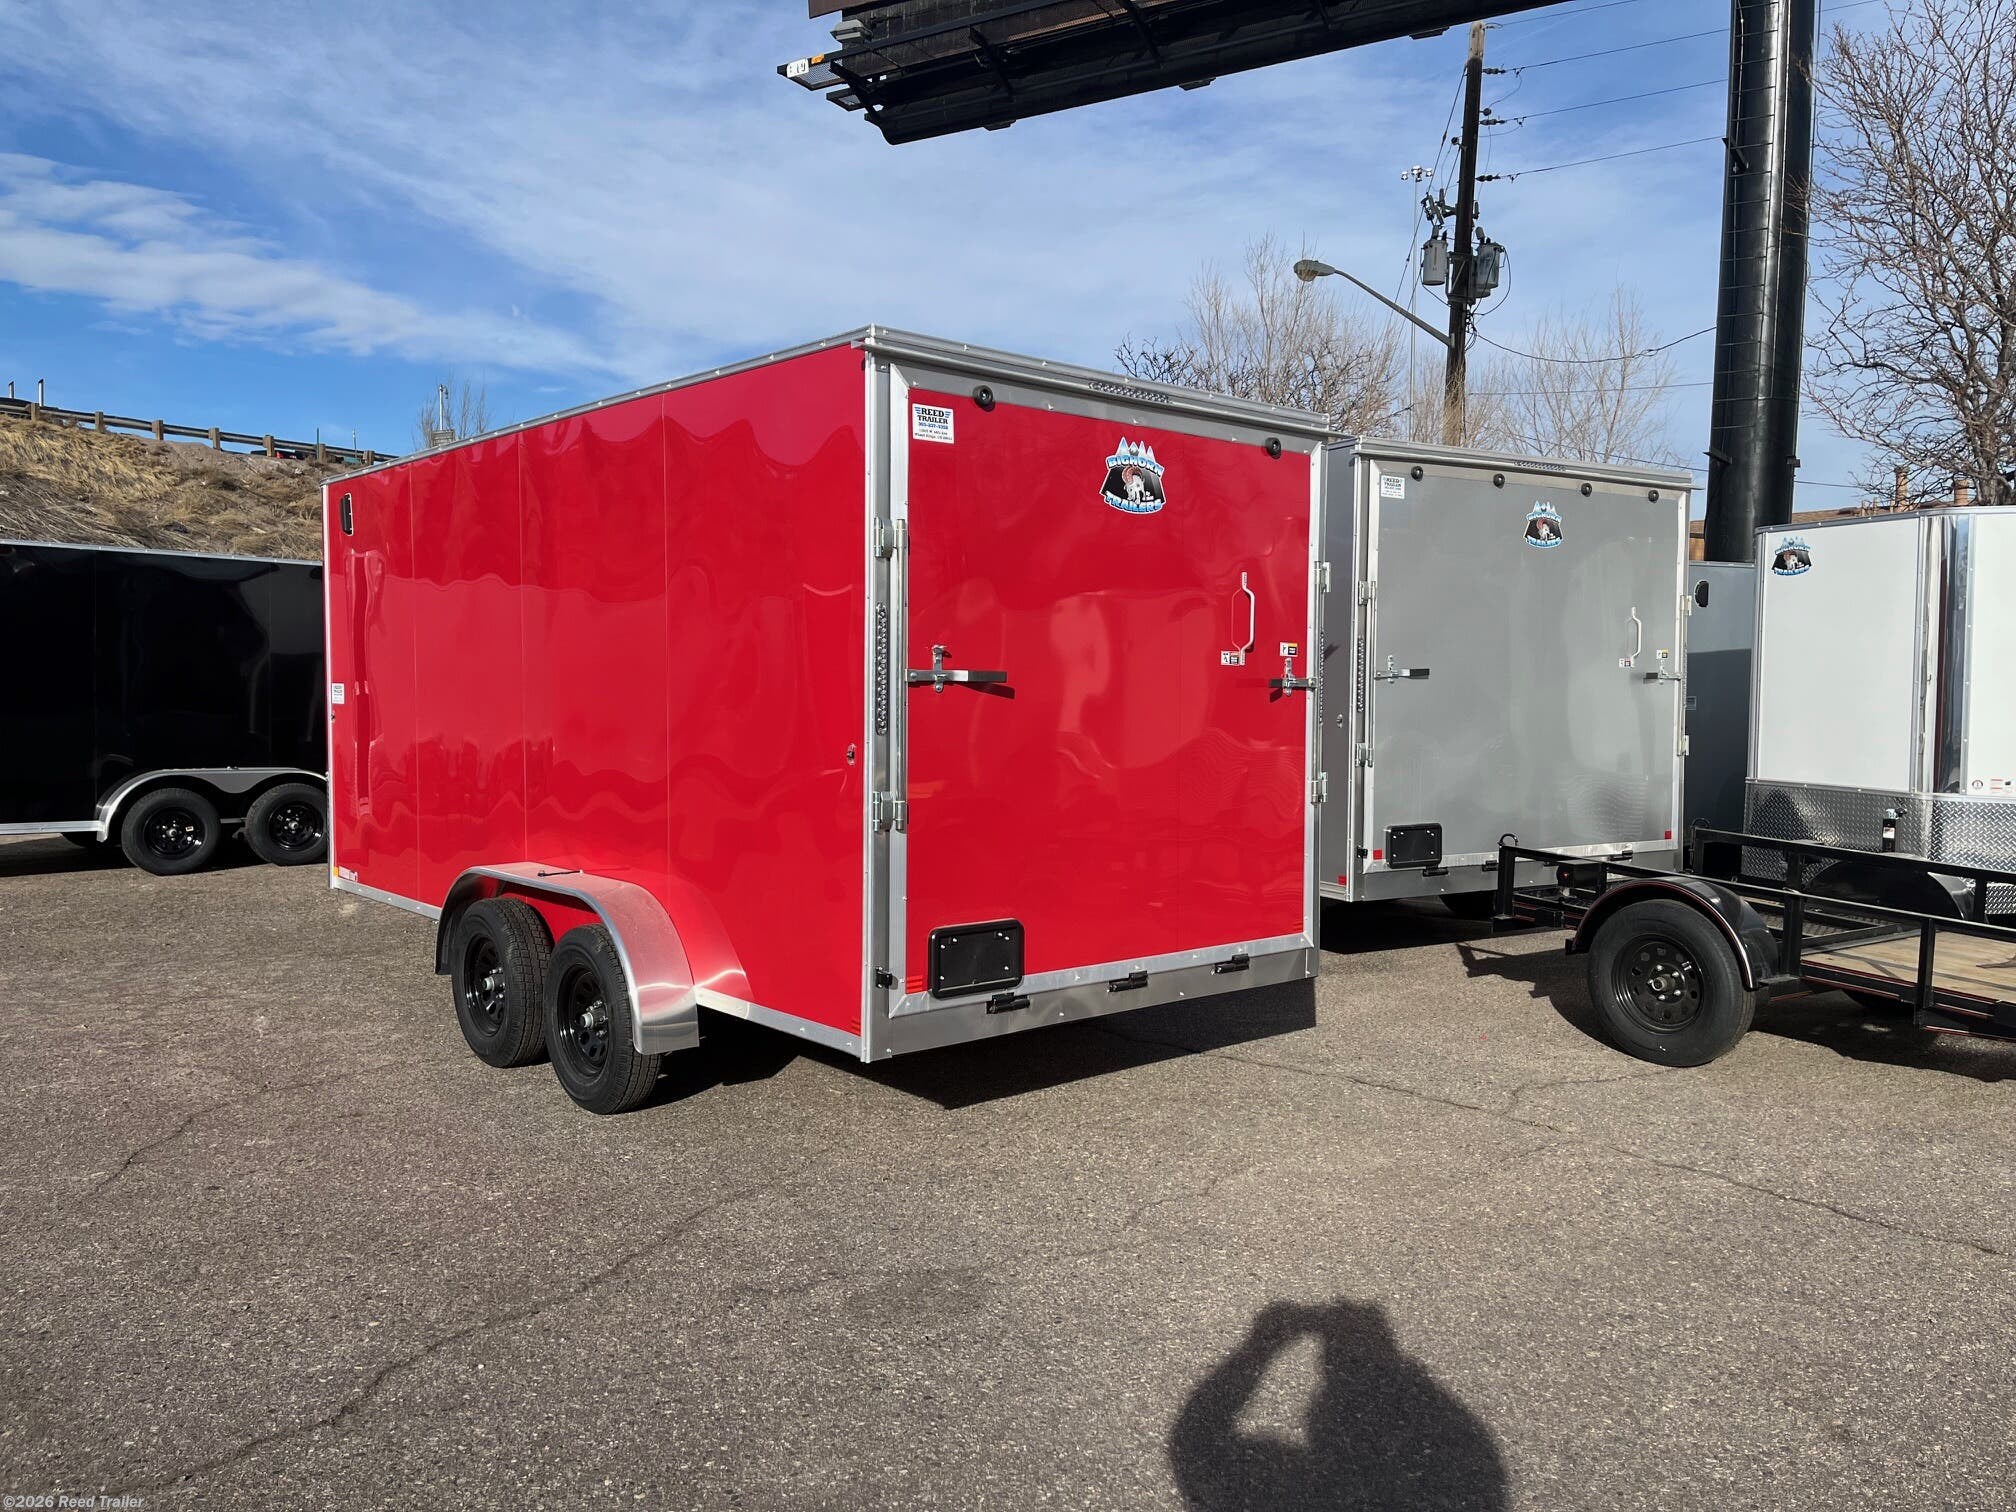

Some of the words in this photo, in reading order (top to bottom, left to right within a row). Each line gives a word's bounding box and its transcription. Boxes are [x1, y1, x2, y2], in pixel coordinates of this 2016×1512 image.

[917, 415, 948, 424] TRAILER
[921, 408, 944, 417] REED
[1107, 455, 1163, 477] BIGHORN
[1106, 491, 1162, 512] TRAILERS
